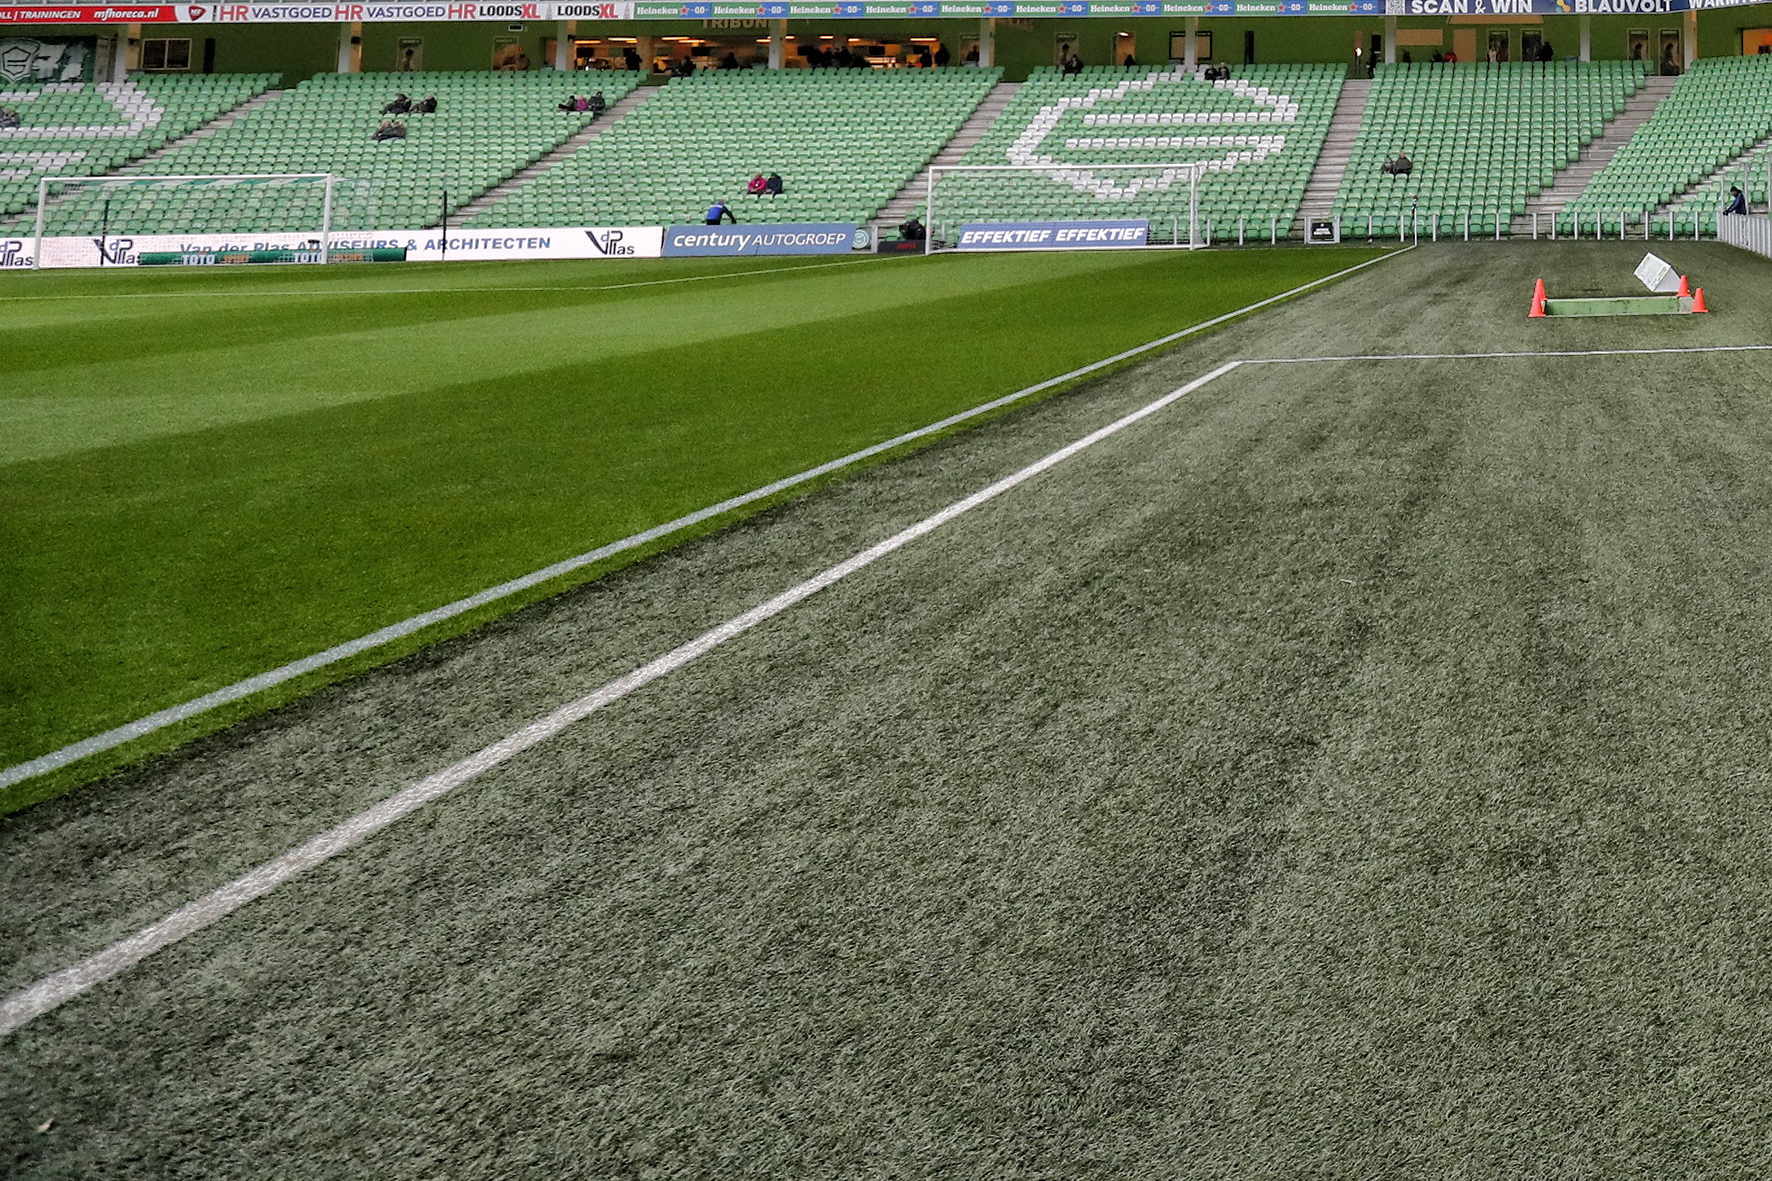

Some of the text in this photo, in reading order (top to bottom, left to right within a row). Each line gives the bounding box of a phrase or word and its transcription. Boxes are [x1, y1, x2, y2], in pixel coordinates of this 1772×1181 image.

[448, 4, 476, 19] HR
[480, 3, 541, 19] LOODSXL
[558, 3, 618, 19] LOODSXL
[637, 6, 678, 15] Heineken
[714, 6, 755, 14] Heineken
[790, 6, 831, 14] Heineken
[866, 6, 907, 14] Heineken
[941, 5, 982, 13] Heineken
[1016, 4, 1056, 12] Heineken
[1091, 4, 1130, 12] Heineken
[1164, 4, 1203, 12] Heineken
[1237, 4, 1276, 12] Heineken
[1411, 0, 1532, 14] SCAN & WIN
[20, 10, 82, 19] TRAININGEN
[94, 8, 160, 21] mfhoreca.nl
[220, 5, 332, 21] HR VASTGOED
[335, 5, 446, 20] HR VASTGOED
[702, 19, 770, 29] TRIBUN
[960, 227, 1146, 244] EFFEKTIEF EFFEKTIEF
[181, 243, 212, 253] Van
[219, 242, 248, 252] der
[253, 241, 290, 251] Plas
[407, 239, 418, 251] &
[424, 237, 552, 251] ARCHITECTEN
[673, 231, 846, 251] century AUTOGROEP
[182, 254, 216, 265] TOTO
